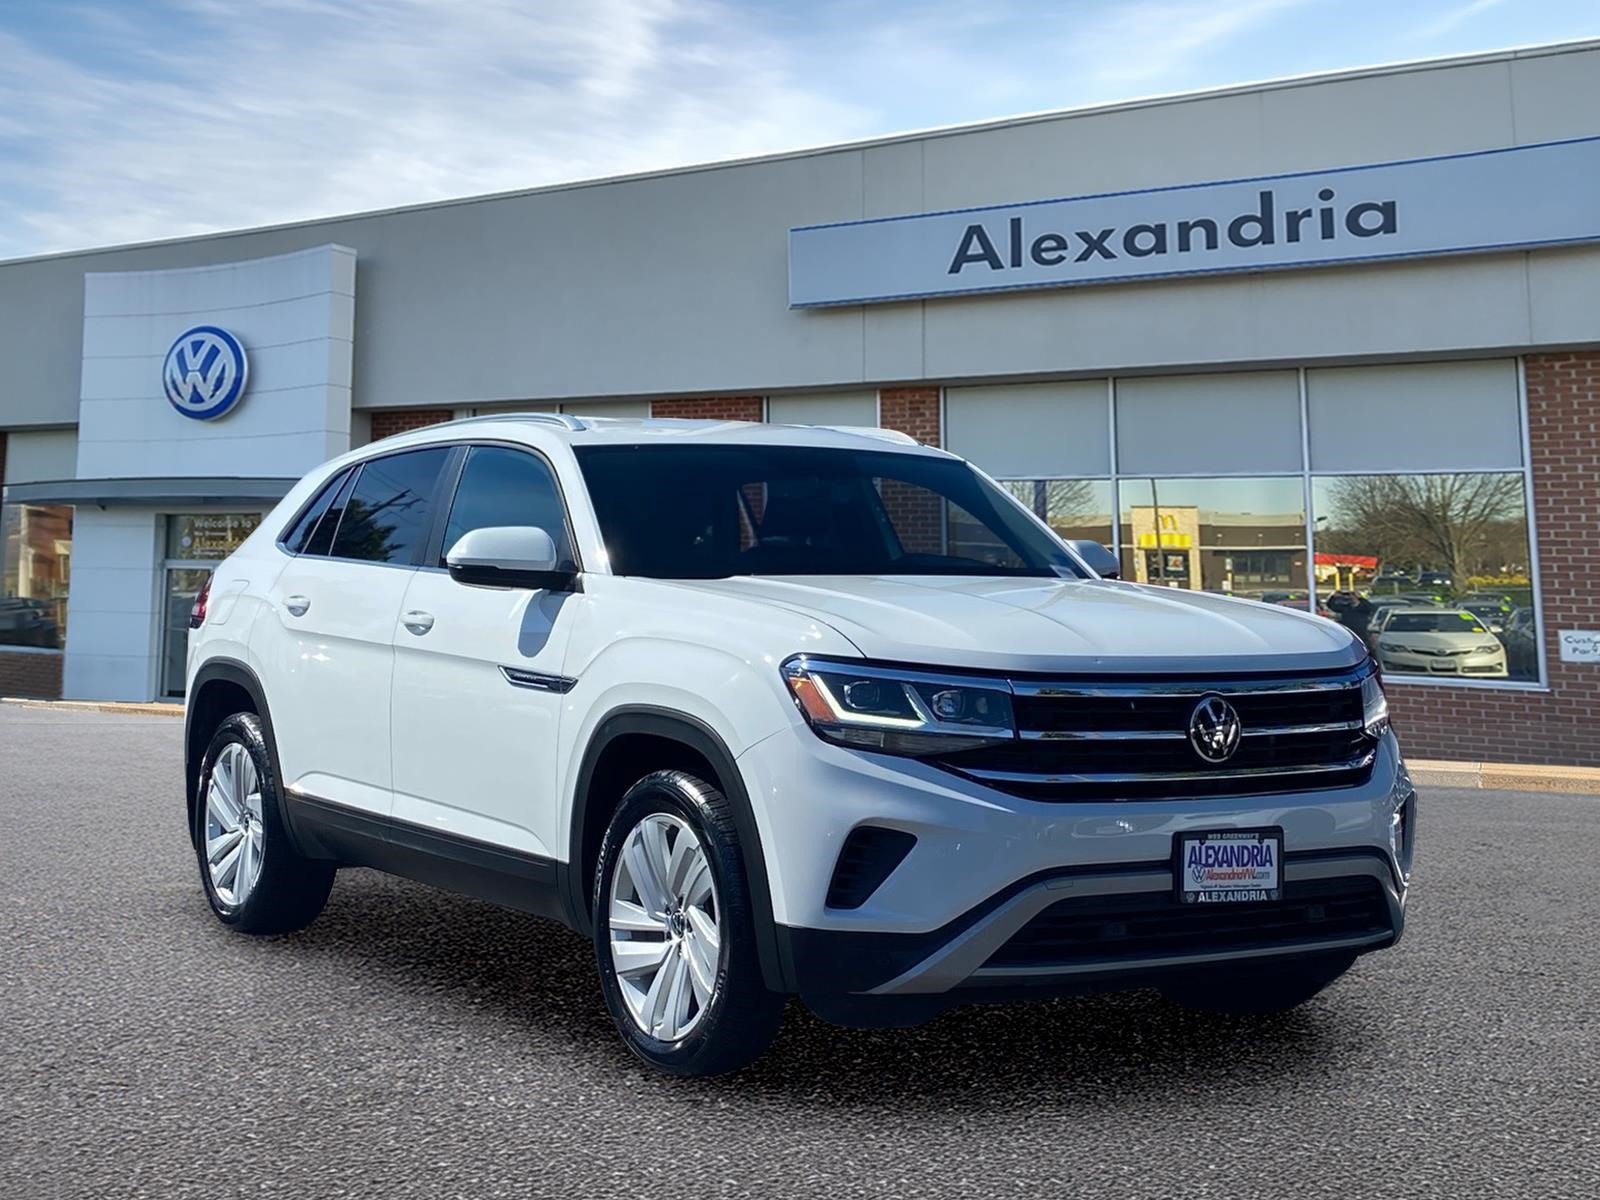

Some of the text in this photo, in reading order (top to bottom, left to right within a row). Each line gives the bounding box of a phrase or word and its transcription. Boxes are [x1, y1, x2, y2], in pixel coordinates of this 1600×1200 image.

[947, 188, 1398, 275] Alexandria
[1187, 844, 1273, 868] ALEXANDRIA
[1197, 890, 1268, 903] ALEXANDRIA
